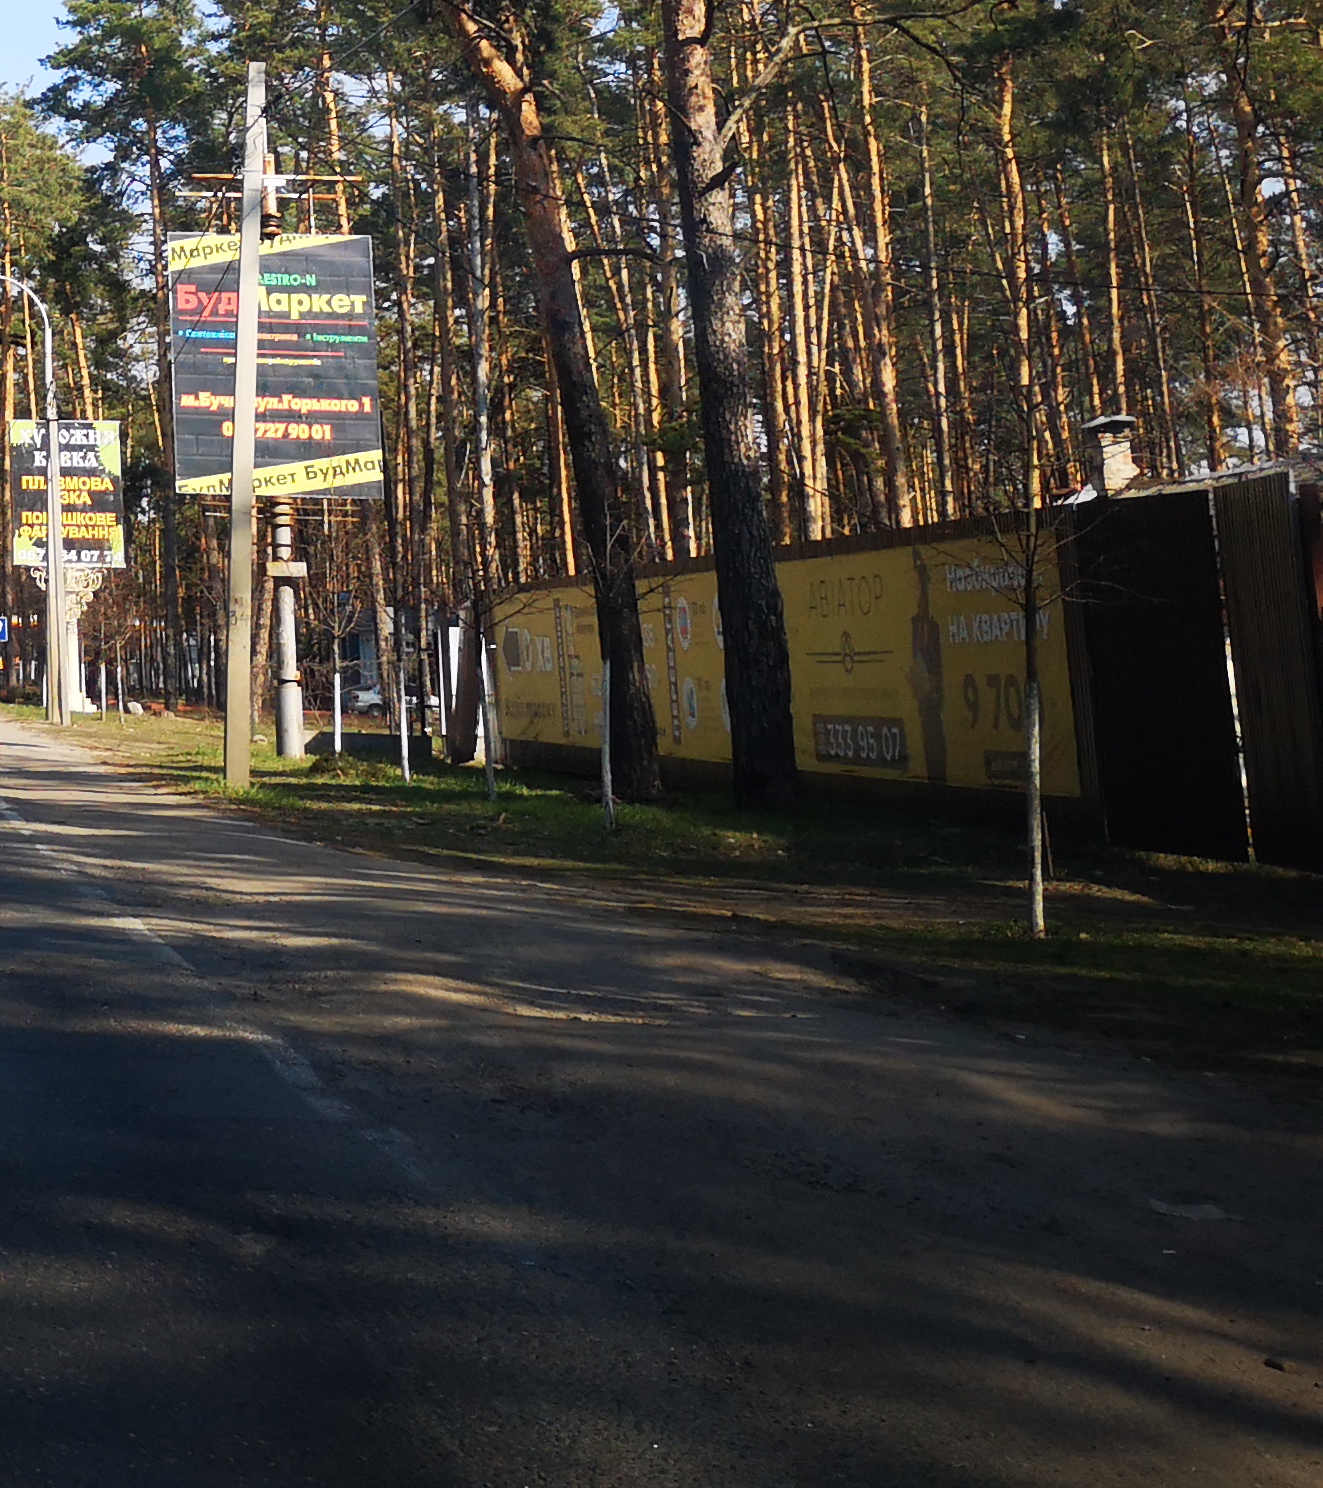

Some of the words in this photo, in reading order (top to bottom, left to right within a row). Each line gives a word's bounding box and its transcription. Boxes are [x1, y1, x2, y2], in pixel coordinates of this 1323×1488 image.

[361, 396, 372, 413] 1
[19, 428, 115, 448] ХУОЖНЯ
[287, 424, 311, 439] 90
[312, 424, 332, 440] 01
[33, 450, 99, 467] КВКА
[808, 574, 885, 619] АВІАТОР
